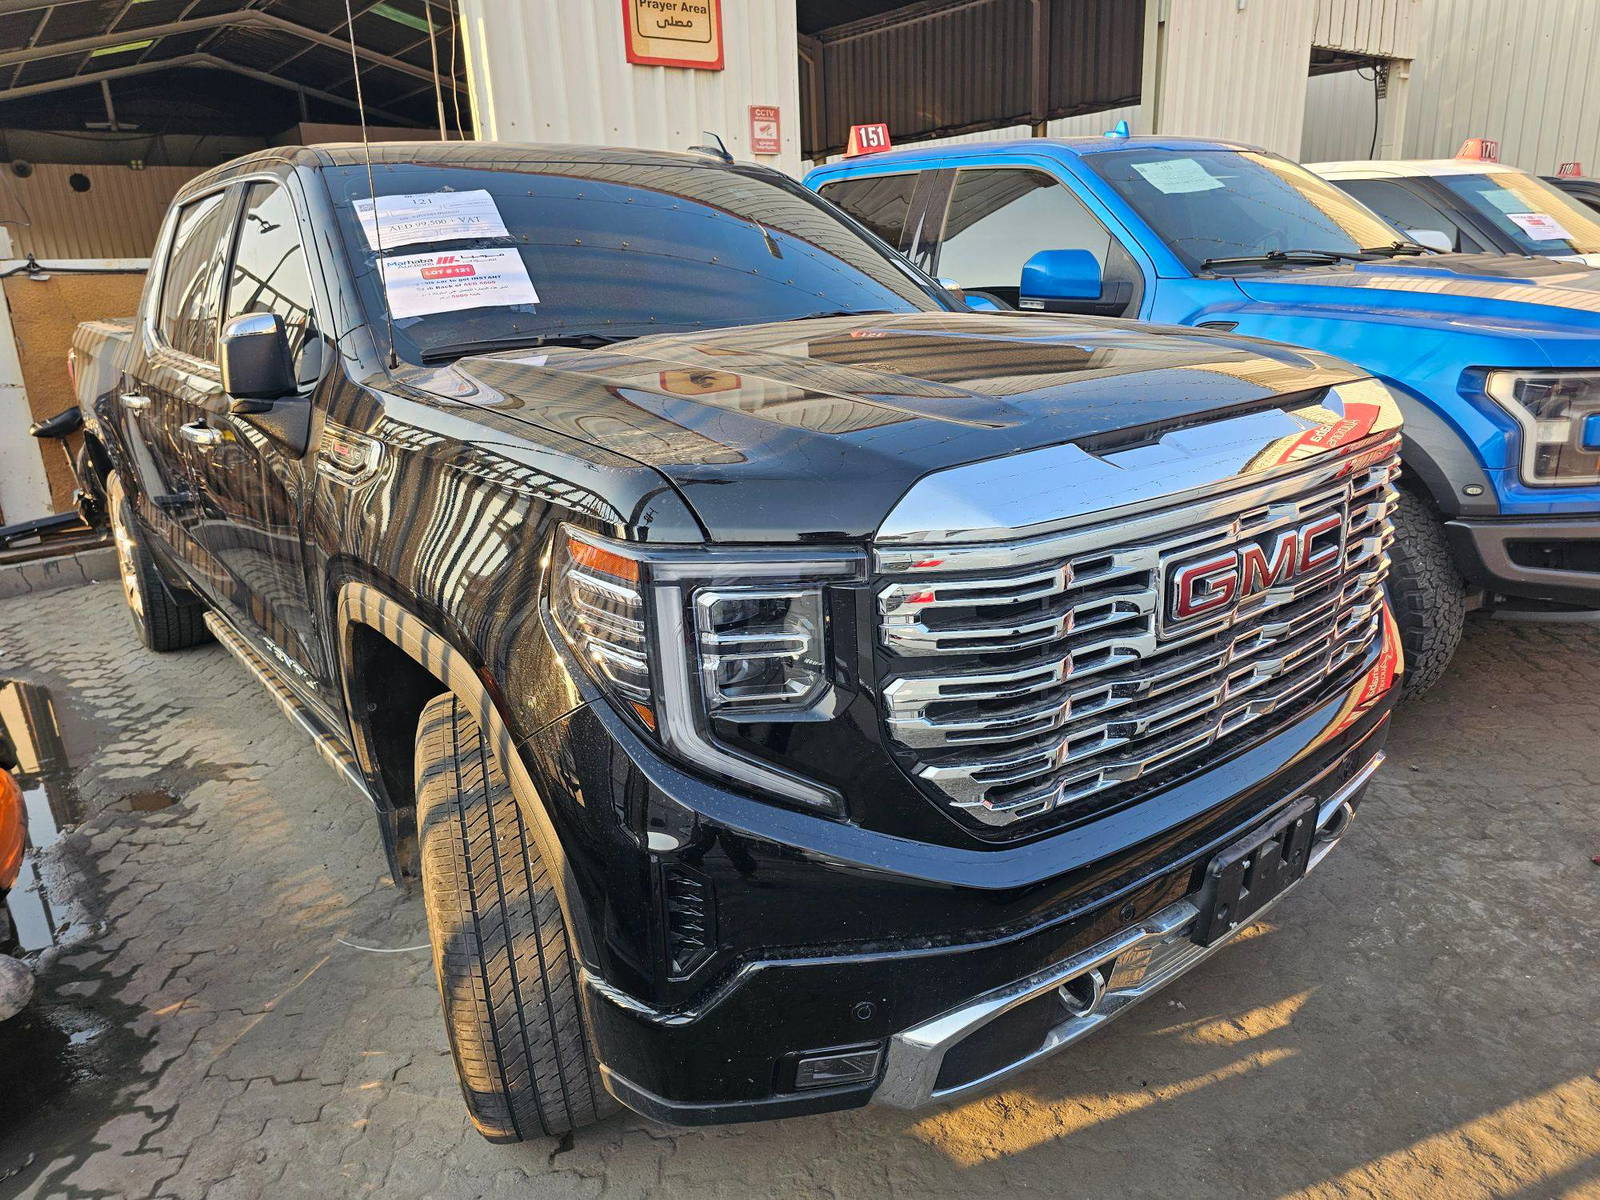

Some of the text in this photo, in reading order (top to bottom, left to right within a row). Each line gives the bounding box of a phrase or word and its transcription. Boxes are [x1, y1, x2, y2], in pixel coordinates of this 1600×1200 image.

[639, 0, 707, 15] Prayer Area
[656, 16, 693, 29] مصلى
[755, 108, 775, 117] CCTV
[859, 126, 885, 148] 151
[1482, 141, 1496, 159] 170
[389, 223, 413, 232] AED
[457, 215, 482, 224] VAT
[386, 258, 434, 268] Marhaba
[1173, 512, 1342, 621] GMC
